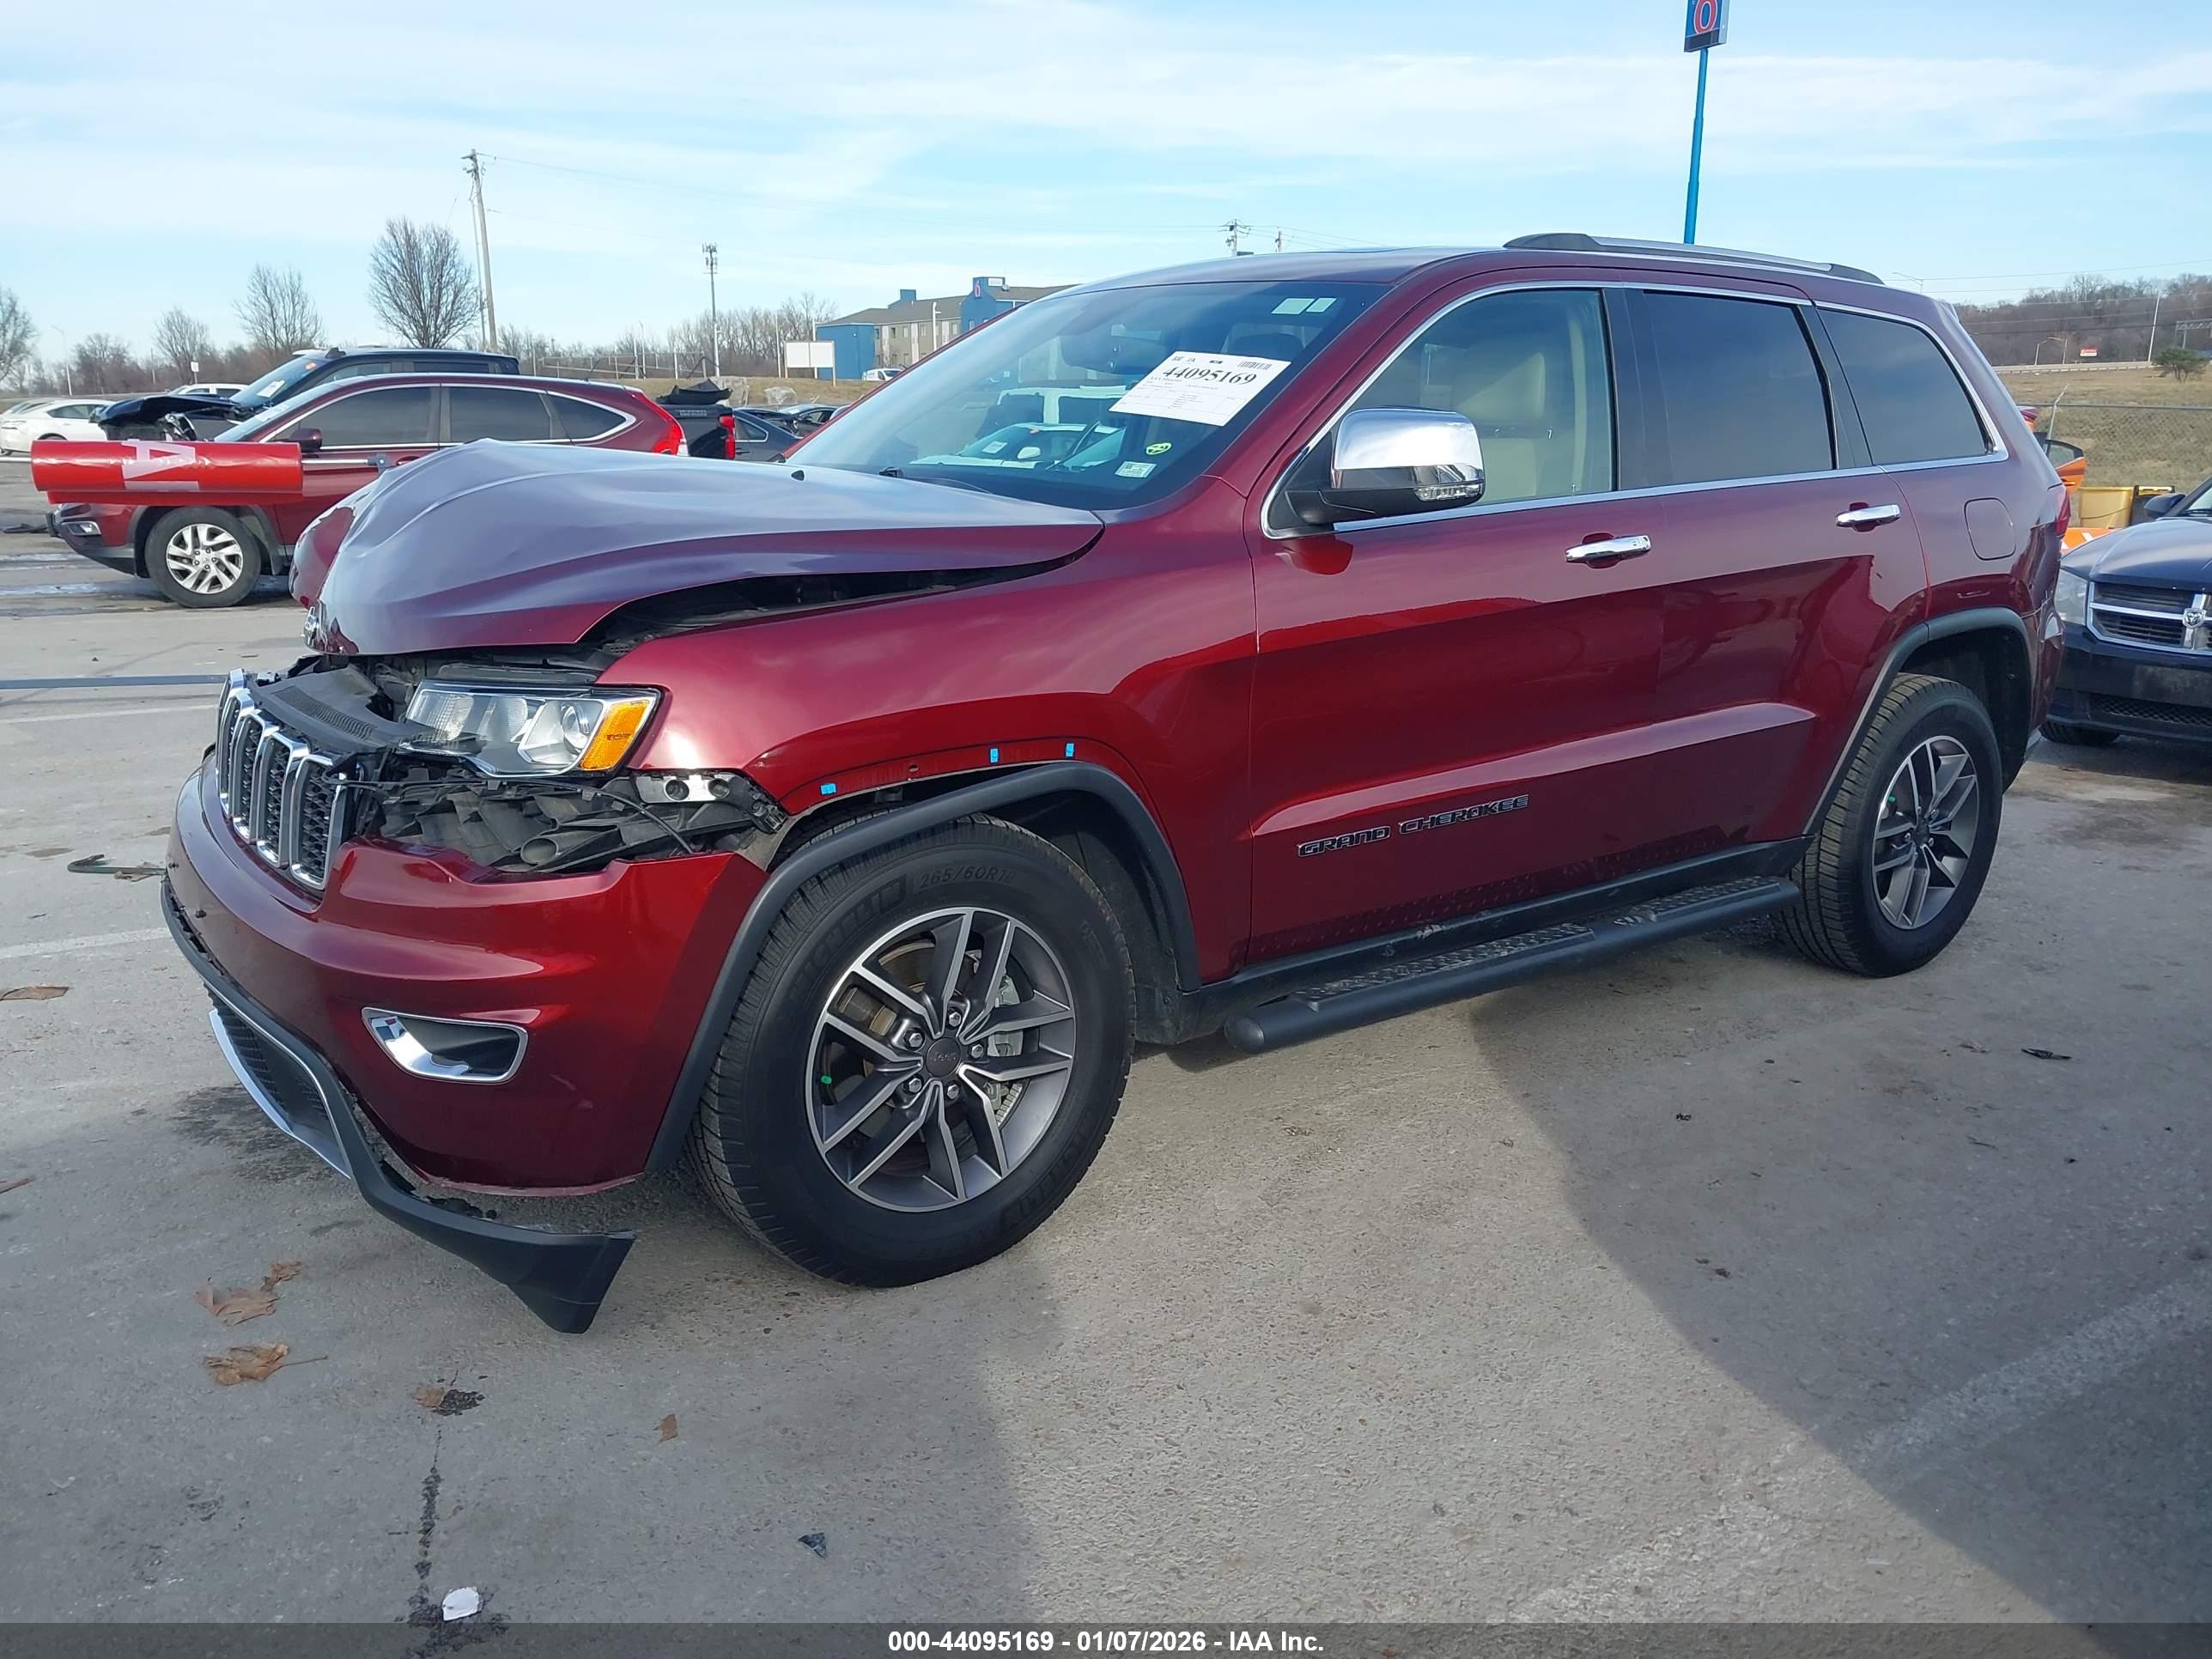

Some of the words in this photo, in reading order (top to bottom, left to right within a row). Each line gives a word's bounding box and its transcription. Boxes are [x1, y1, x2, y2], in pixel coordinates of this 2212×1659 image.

[1163, 367, 1257, 386] 44095169
[1297, 825, 1391, 857] GRAND
[1398, 793, 1528, 834] CHEROKEE
